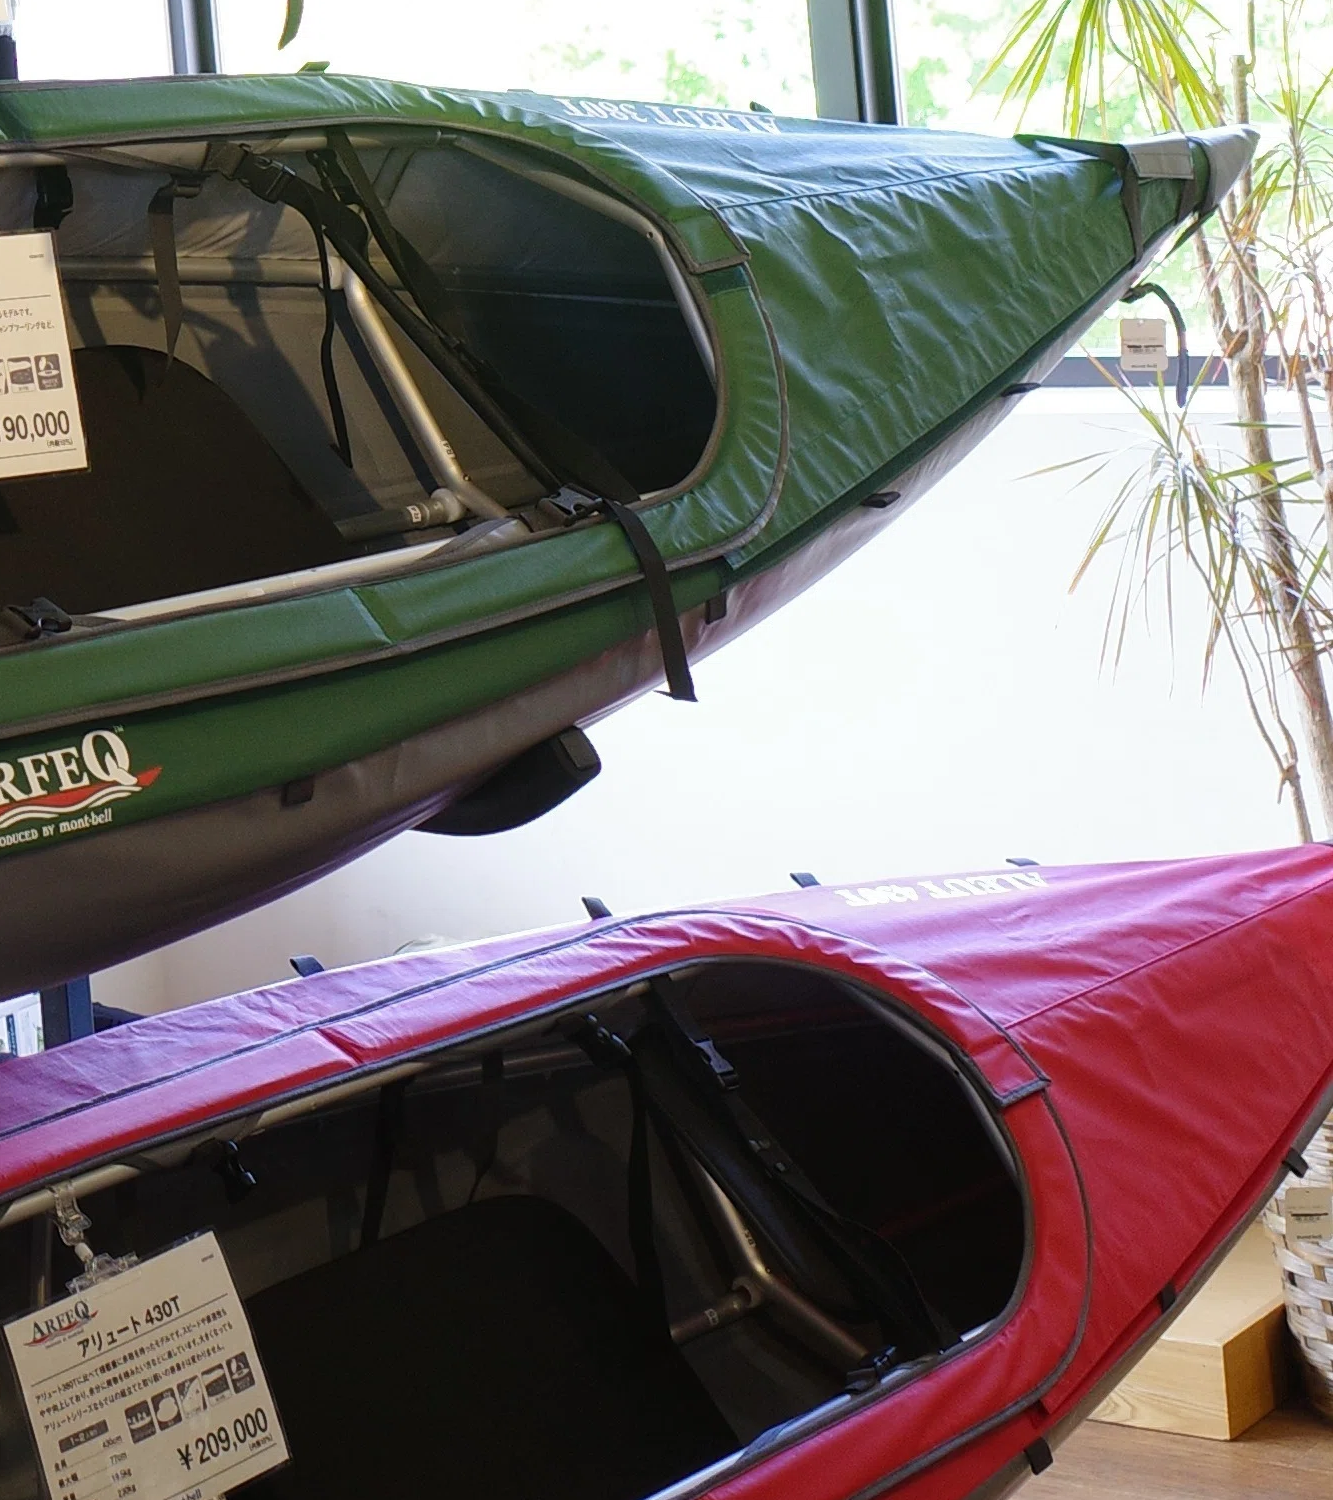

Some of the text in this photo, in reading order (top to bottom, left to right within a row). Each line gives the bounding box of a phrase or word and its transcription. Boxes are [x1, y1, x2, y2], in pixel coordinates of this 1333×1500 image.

[553, 98, 782, 135] ALEUT 380T
[42, 825, 55, 837] BY
[31, 1300, 91, 1341] ARFEQ
[77, 1315, 142, 1358] アリュート
[144, 1295, 181, 1326] 430T
[177, 1407, 268, 1470] ¥209,000
[109, 1452, 128, 1466] 77cm
